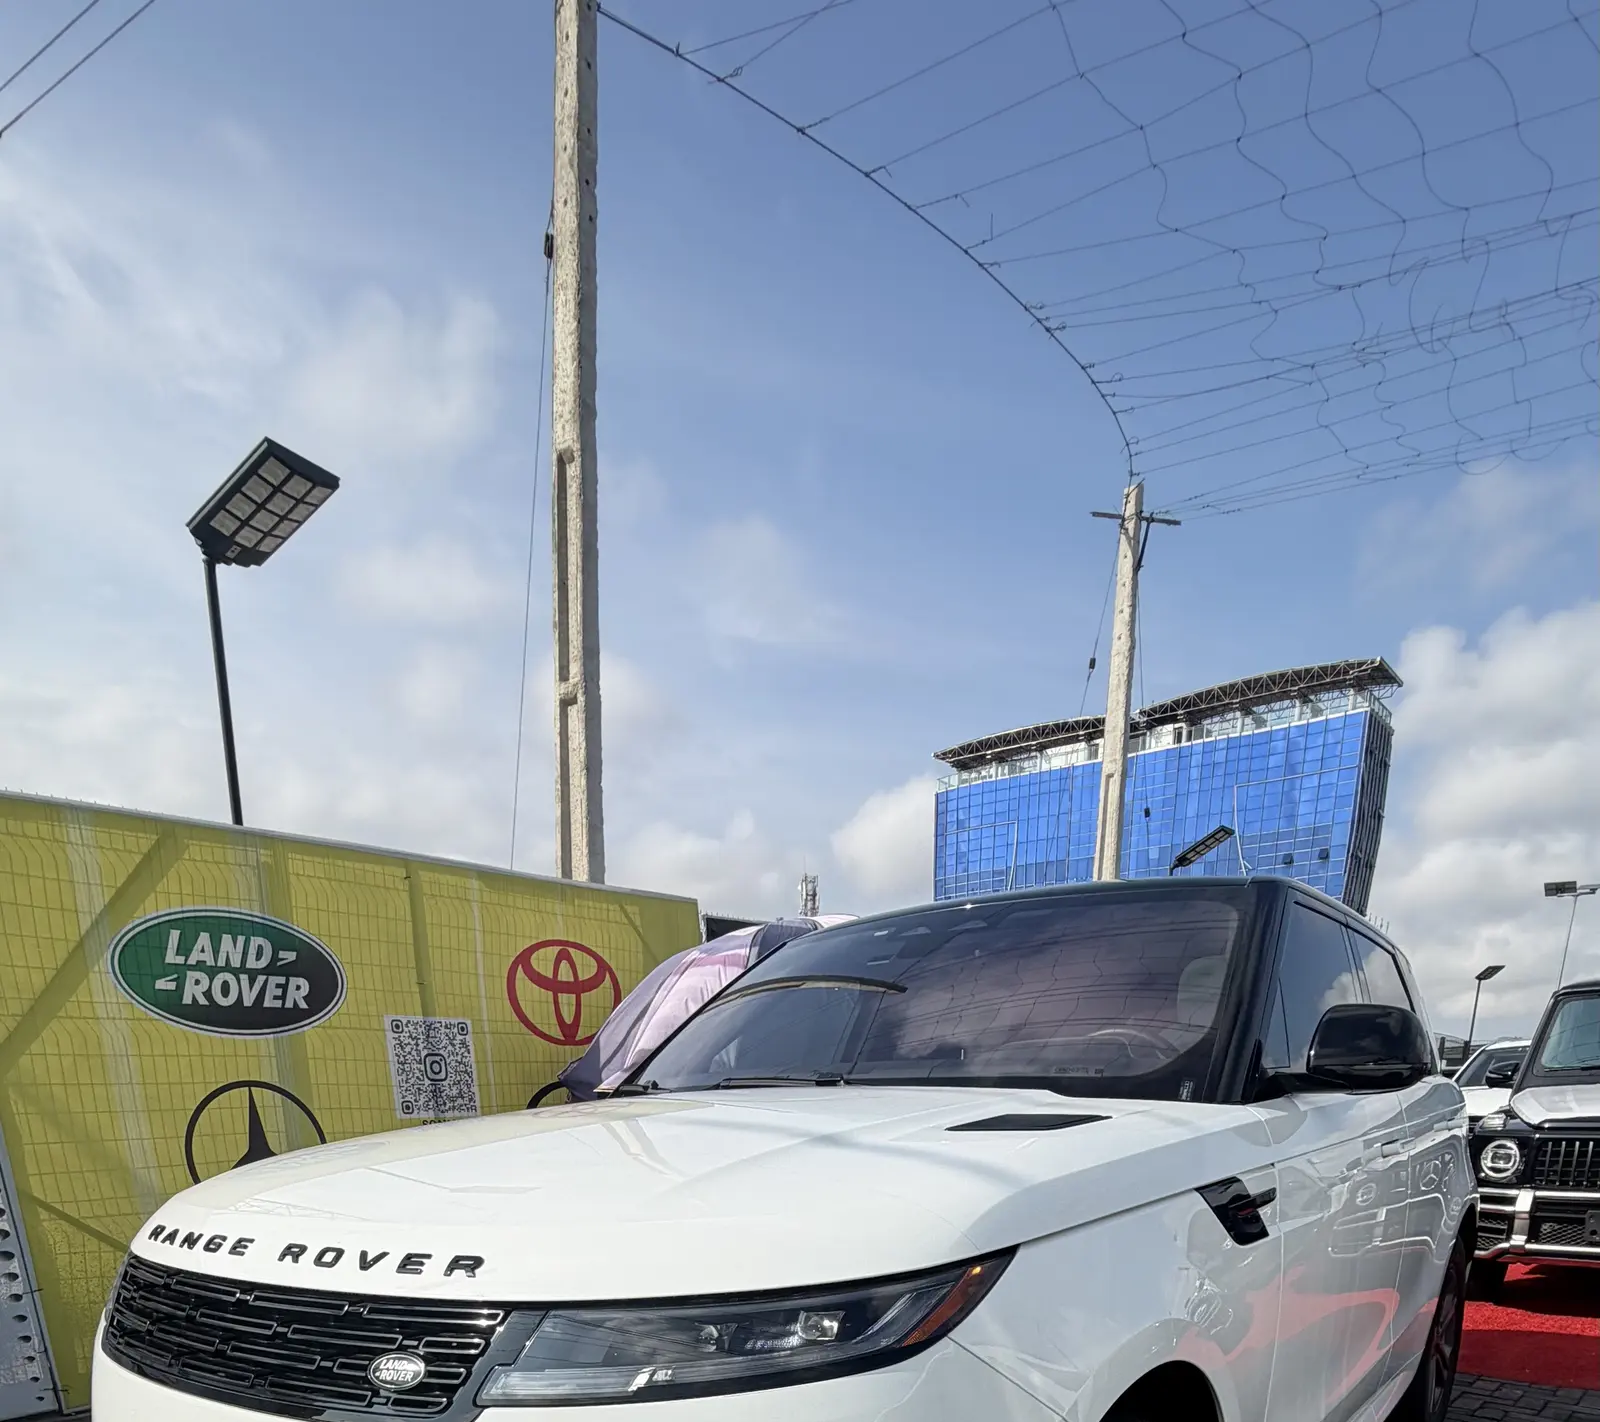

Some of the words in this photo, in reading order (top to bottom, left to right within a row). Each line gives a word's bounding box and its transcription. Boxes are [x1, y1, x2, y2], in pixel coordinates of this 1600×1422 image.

[164, 929, 273, 969] LAND
[182, 970, 310, 1009] ROVER
[148, 1224, 256, 1257] RANGE
[277, 1242, 486, 1279] ROVER
[379, 1359, 408, 1370] LAND
[379, 1370, 414, 1382] ROVER
